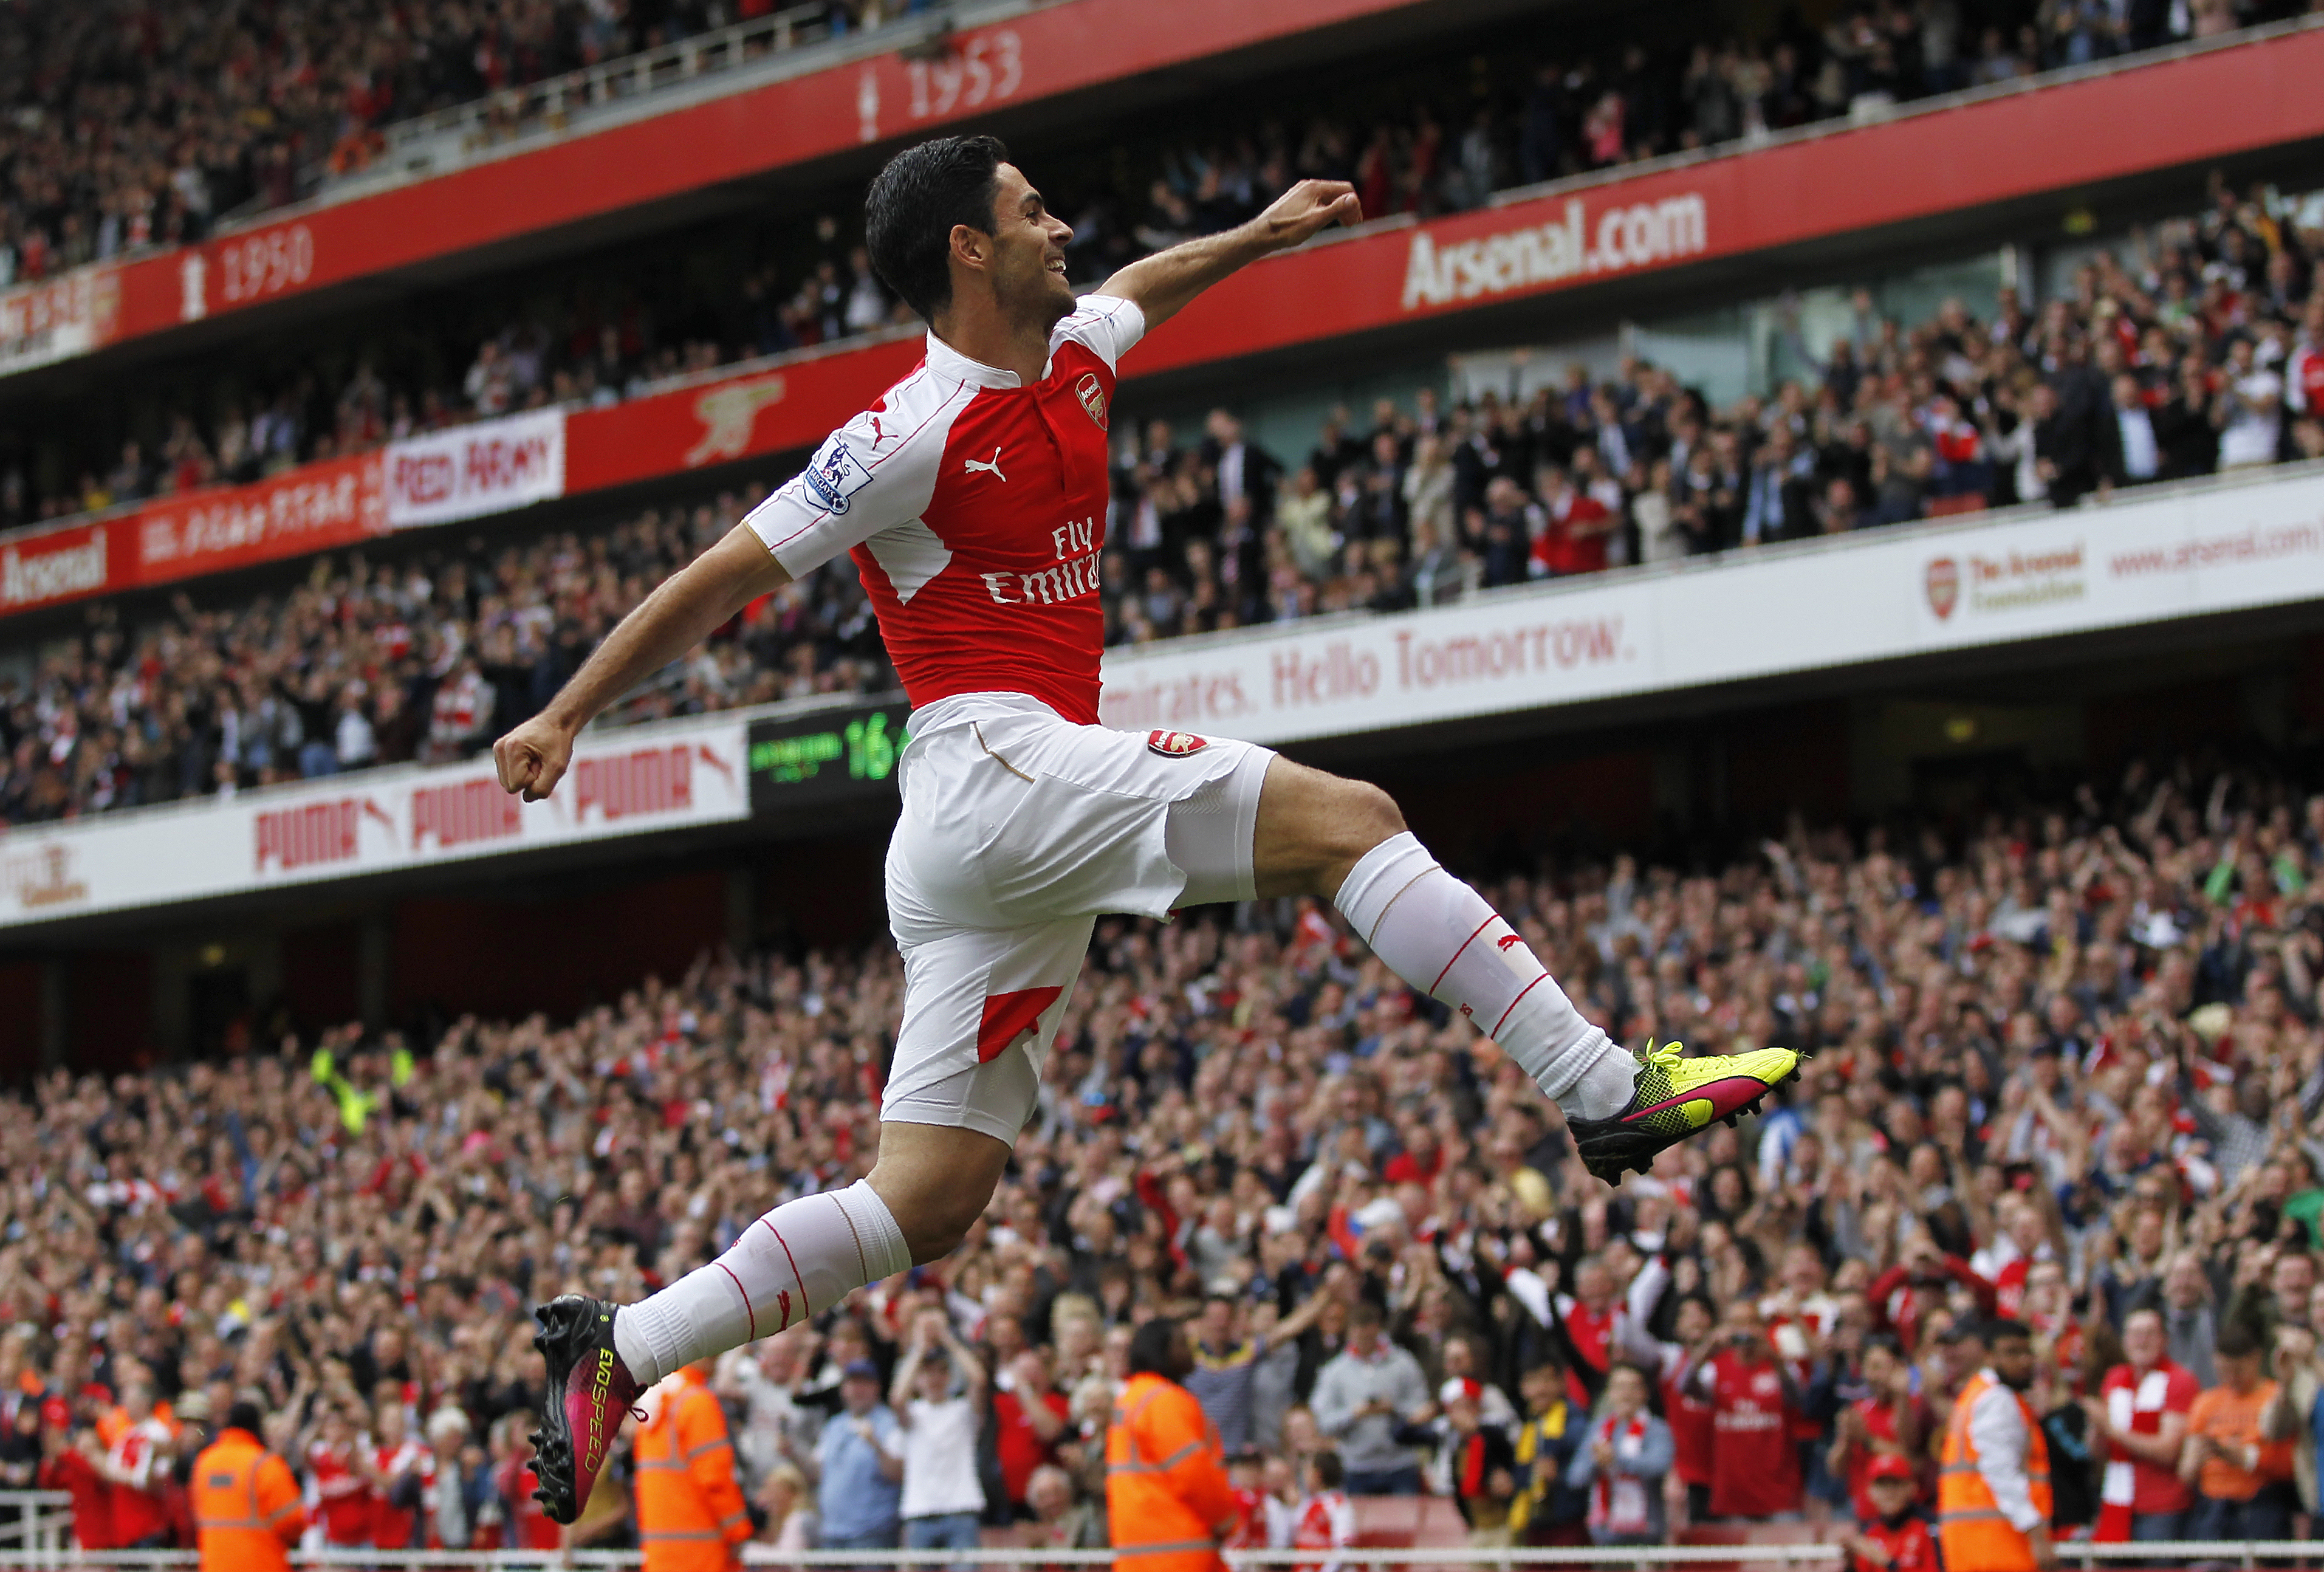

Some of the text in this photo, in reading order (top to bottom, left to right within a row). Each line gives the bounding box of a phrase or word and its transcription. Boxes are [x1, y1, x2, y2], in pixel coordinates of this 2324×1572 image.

[907, 29, 1023, 119] 1953
[221, 222, 314, 301] 1950
[1401, 191, 1707, 309] Arsenal.com
[809, 468, 835, 498] BARCLAYS
[2, 525, 108, 603] Arsenal
[1052, 517, 1092, 560] Fly
[1102, 610, 1638, 727] mirates. Hello Tomorrow.
[411, 775, 523, 851] PUMA
[575, 741, 691, 825] PUMA
[256, 796, 359, 874] PUMA
[585, 1347, 614, 1473] EVOSPEED
